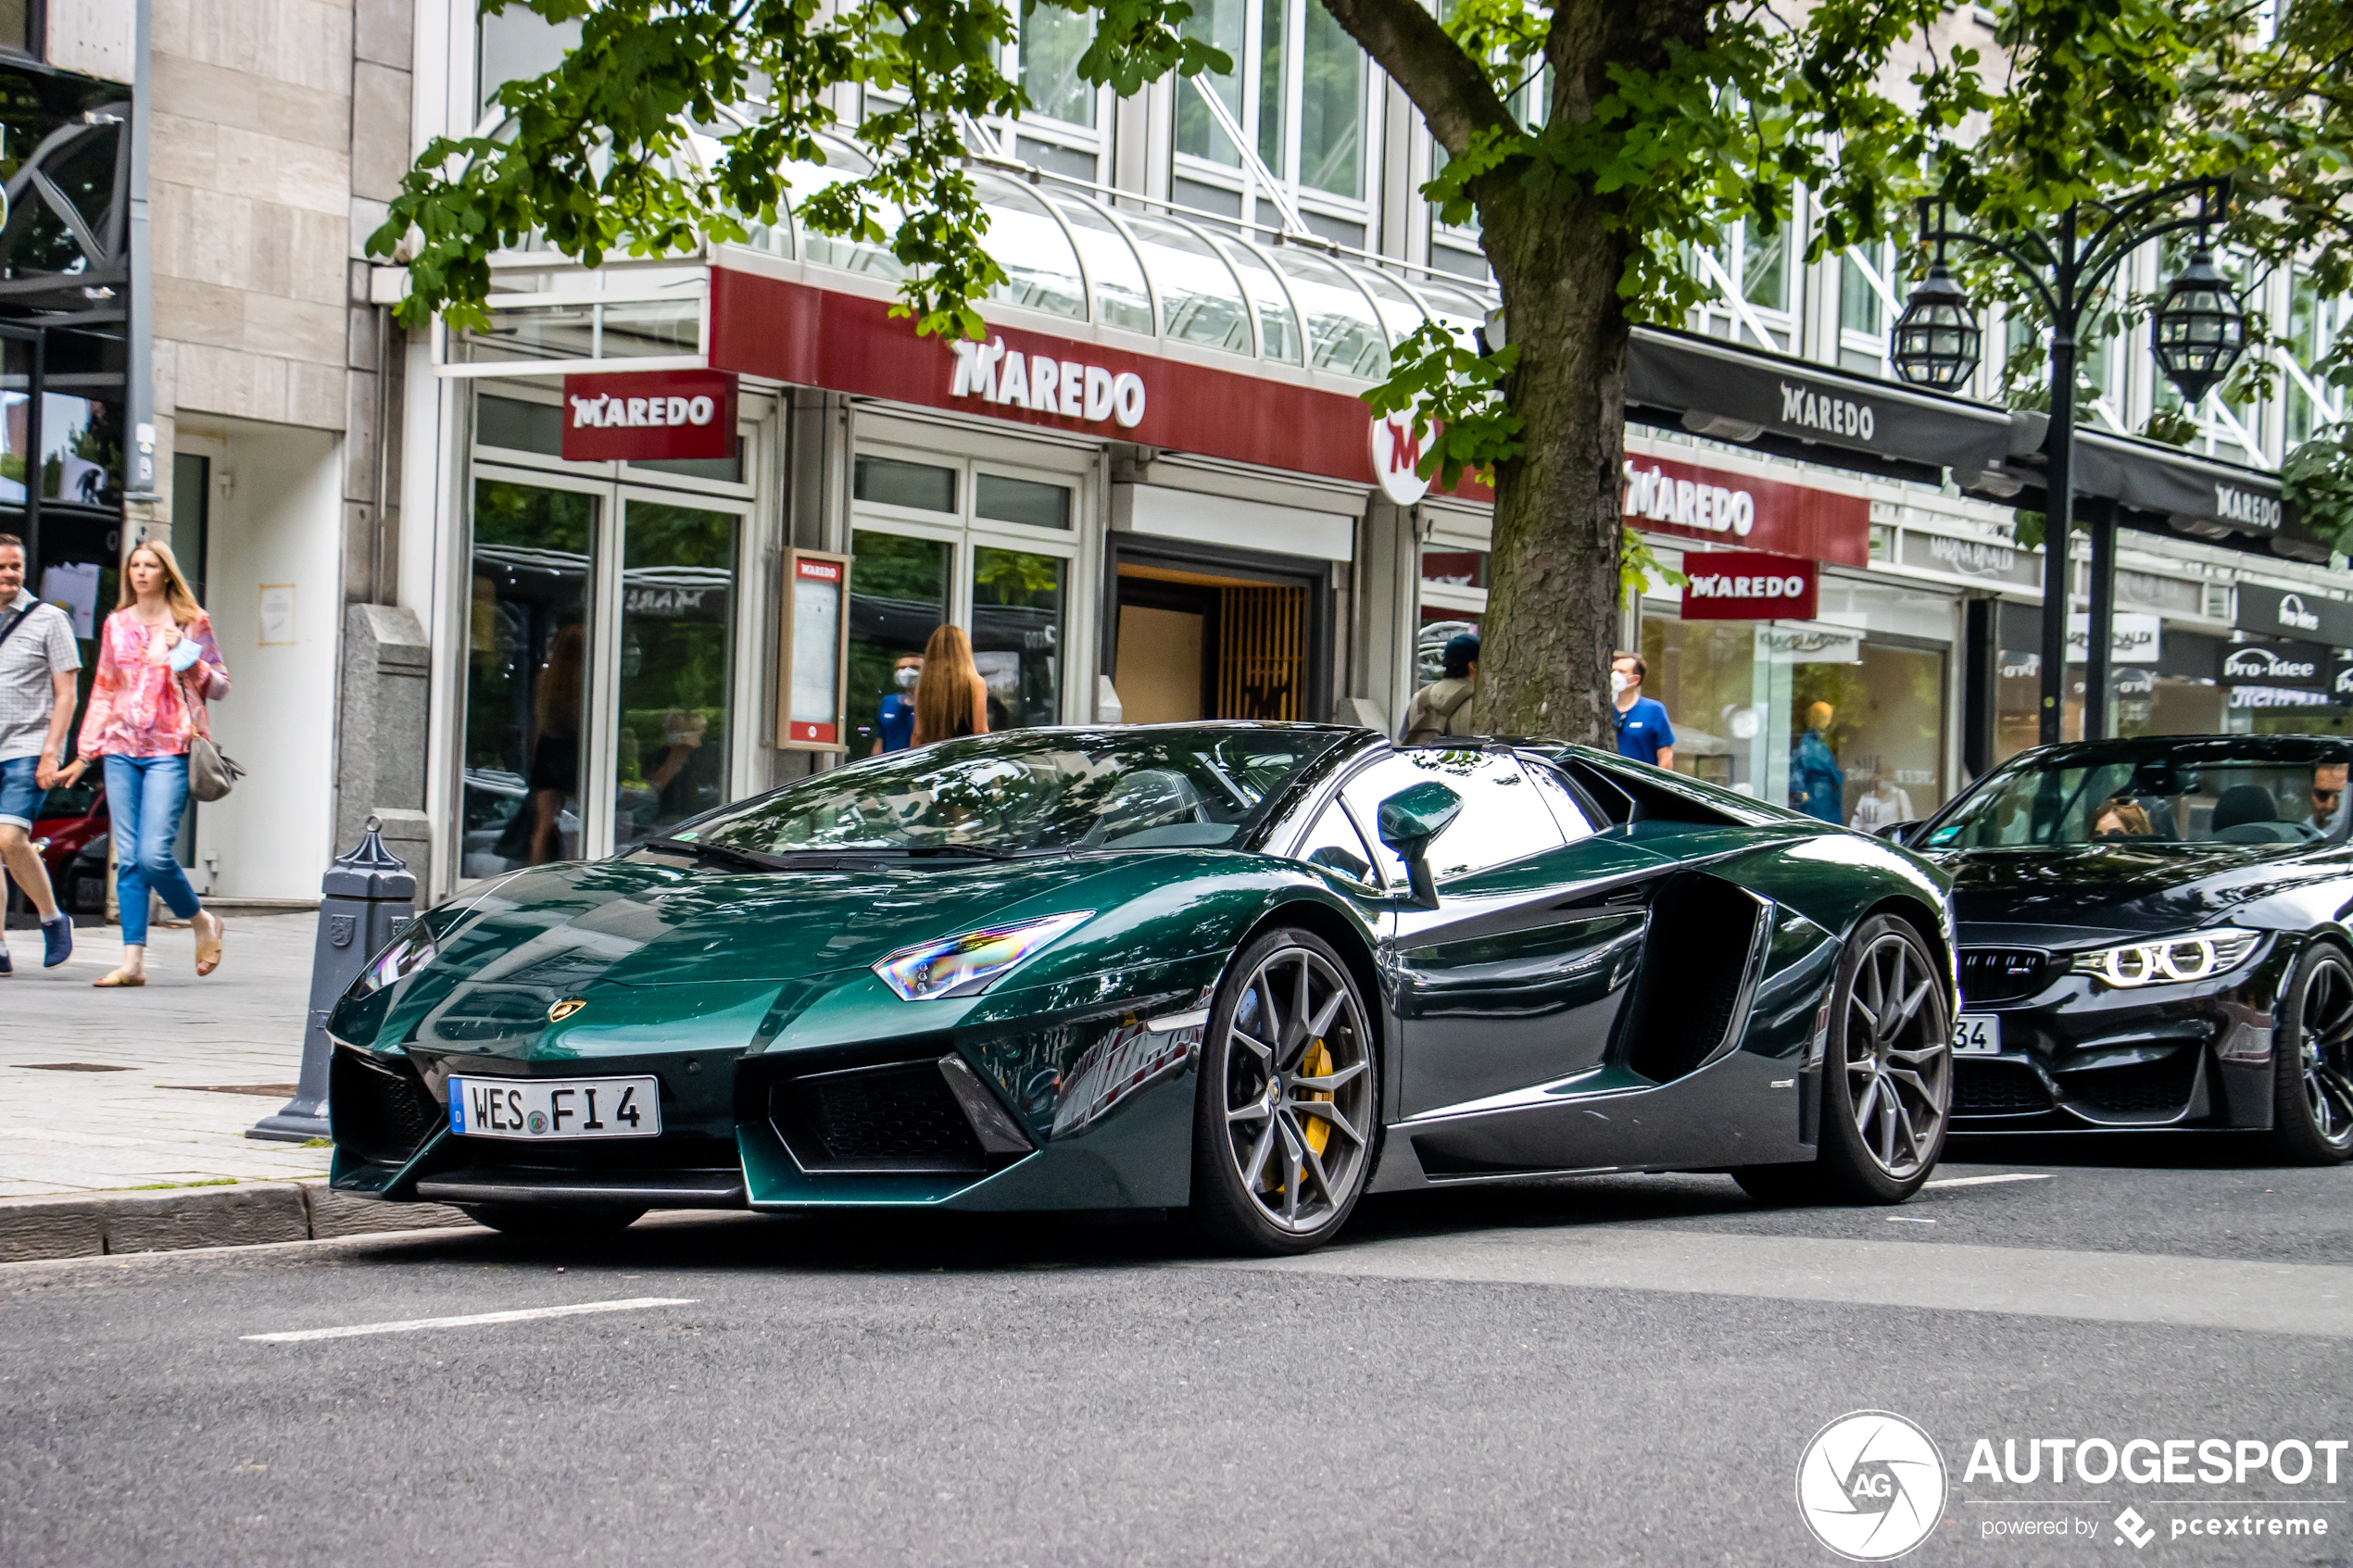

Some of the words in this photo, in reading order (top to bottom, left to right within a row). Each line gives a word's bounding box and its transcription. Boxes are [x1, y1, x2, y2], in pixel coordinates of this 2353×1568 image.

[950, 335, 1146, 428] MAREDO
[570, 393, 715, 428] MAREDO
[1780, 380, 1874, 441] MAREDO
[1623, 460, 1755, 536] MAREDO
[2215, 483, 2282, 530] MAREDO
[1689, 573, 1805, 598] MAREDO
[2223, 654, 2314, 677] Pro-idee
[472, 1086, 524, 1130] WES
